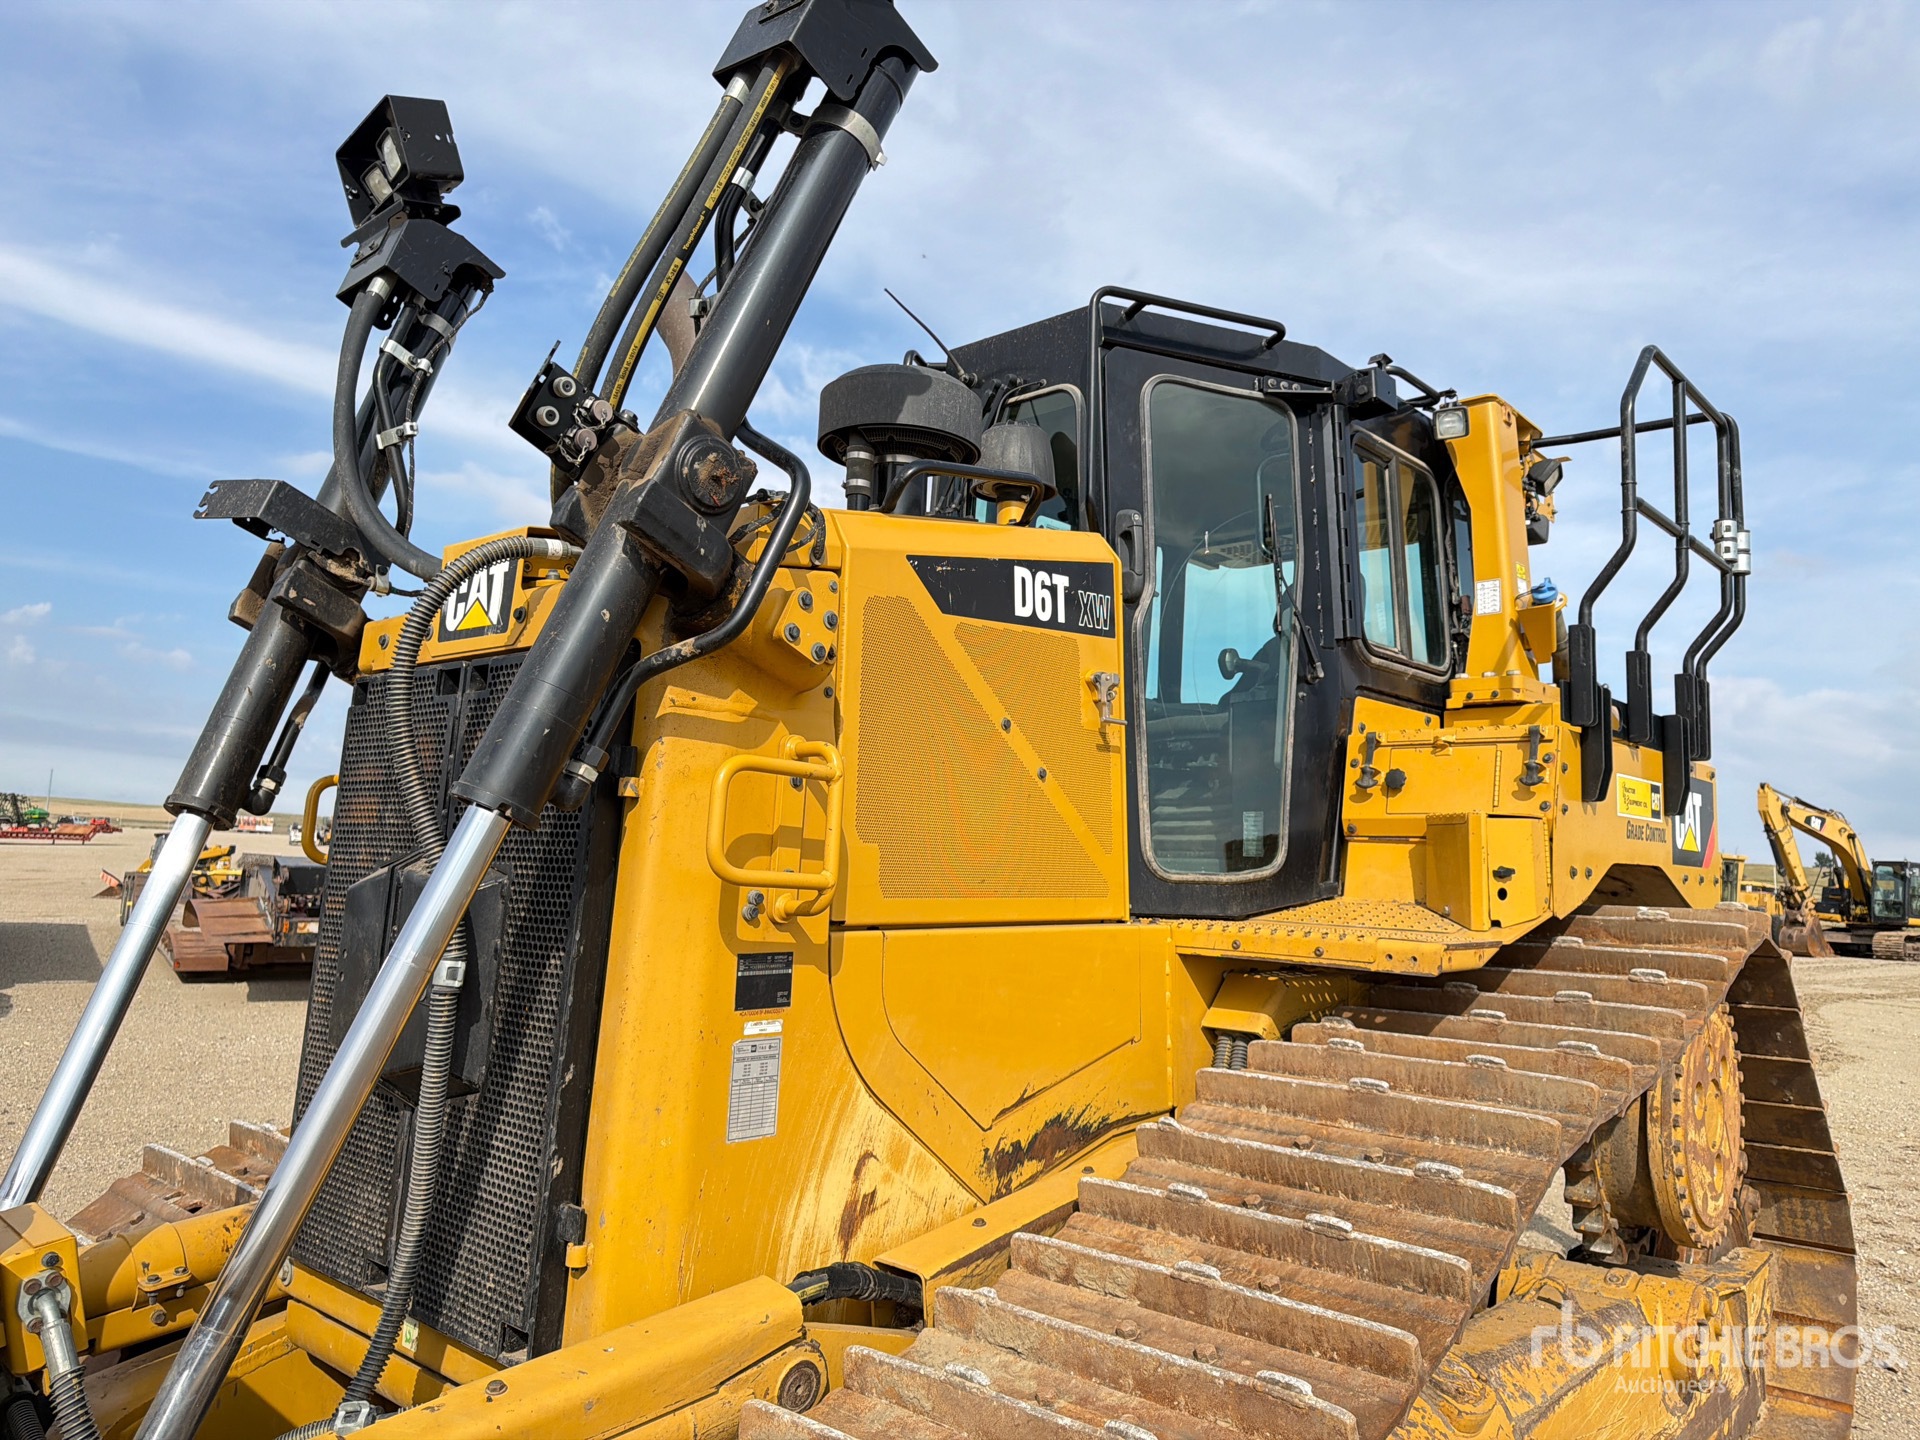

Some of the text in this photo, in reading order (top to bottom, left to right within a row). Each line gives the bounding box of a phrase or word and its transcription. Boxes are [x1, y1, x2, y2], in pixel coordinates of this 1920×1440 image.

[446, 558, 509, 632] CAT
[1013, 565, 1111, 631] D6T XW
[1626, 820, 1667, 843] GRADE CONTROL
[1675, 791, 1702, 853] CAT
